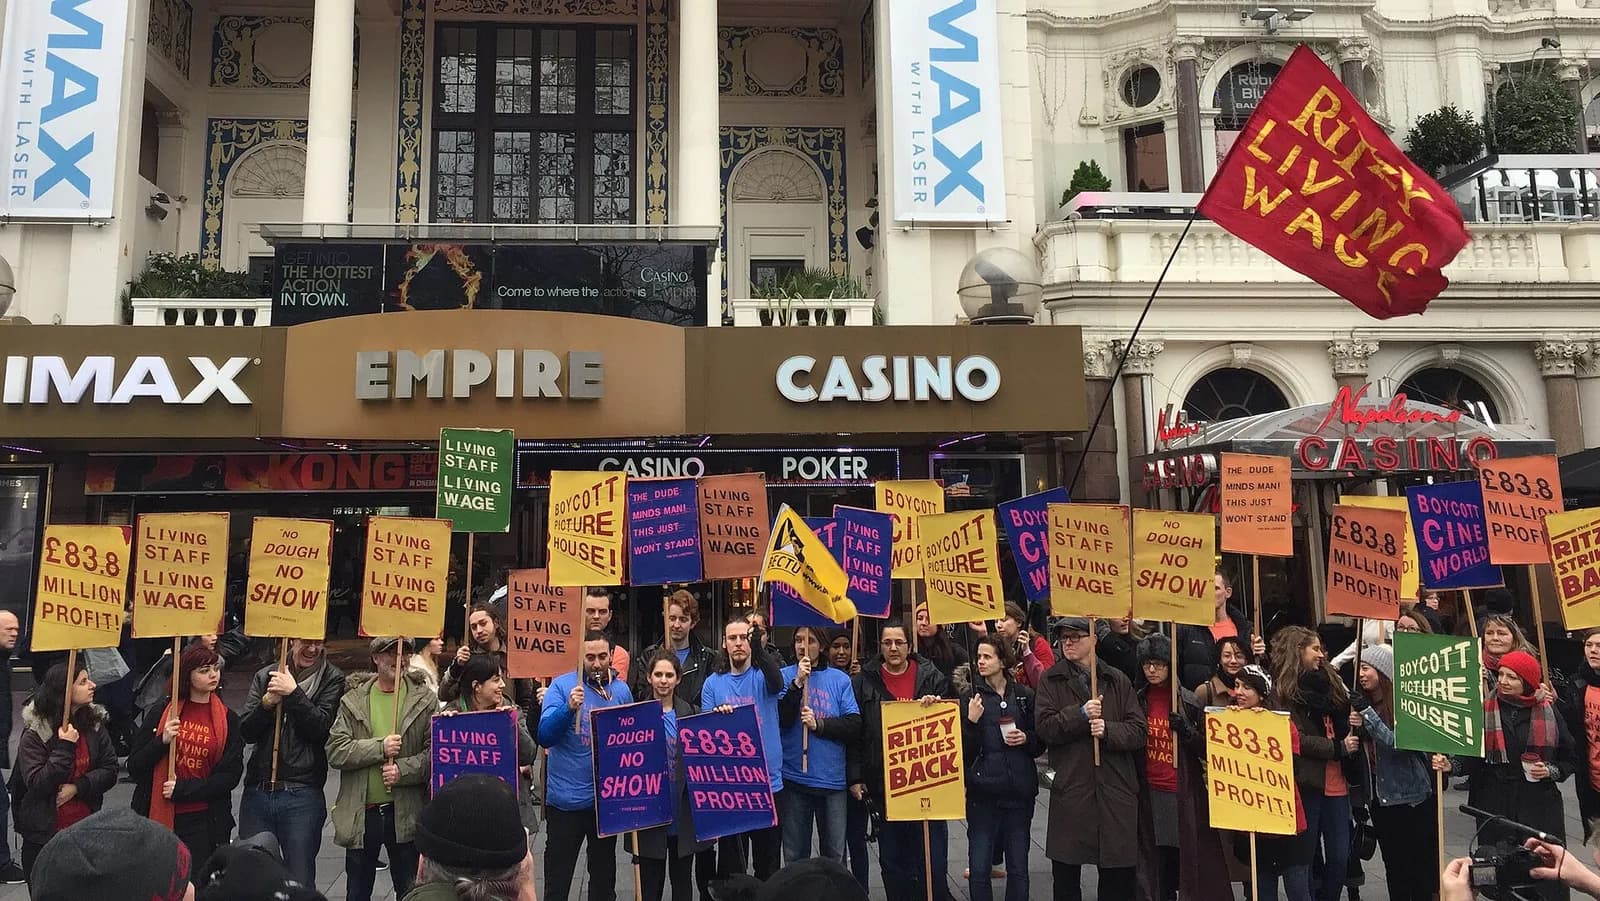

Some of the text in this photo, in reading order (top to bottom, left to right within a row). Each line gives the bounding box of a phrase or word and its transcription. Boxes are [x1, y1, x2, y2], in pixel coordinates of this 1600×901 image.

[11, 48, 36, 196] WITH LASER
[911, 62, 927, 202] WITH LASER
[282, 265, 374, 279] THE HOTTEST
[280, 280, 340, 292] ACTION
[498, 286, 646, 297] Come to where the action is
[280, 292, 349, 306] IN TOWN.
[2, 355, 254, 404] IMAX
[354, 348, 605, 400] EMPIRE
[776, 354, 1001, 402] CASINO
[446, 440, 496, 457] LIVING
[1299, 436, 1498, 470] CASINO
[268, 453, 406, 490] KONG
[445, 455, 498, 473] STAFF
[598, 456, 869, 480] CASINO POKER
[444, 476, 501, 494] LIVING
[654, 488, 680, 498] DUDE
[1482, 468, 1554, 500] £83.8
[444, 492, 496, 512] WAGE
[554, 476, 618, 516] BOYCOTT
[704, 489, 750, 501] LIVING
[885, 488, 937, 514] BOYCOTT
[632, 504, 686, 520] MINDS MAN!
[704, 503, 754, 518] STAFF
[1416, 494, 1480, 520] BOYCOTT
[1488, 500, 1558, 520] MILLIO
[554, 511, 614, 536] PICTURE
[633, 522, 679, 536] THIS JUST
[706, 524, 760, 538] LIVING
[848, 520, 880, 540] IVING
[1054, 516, 1110, 536] LIVING
[1492, 522, 1546, 545] PROFI
[146, 528, 208, 546] LIVING
[375, 530, 431, 551] LIVING
[926, 514, 984, 558] BOYCOTT
[1055, 532, 1114, 554] STAFF
[1146, 532, 1203, 549] DOUGH
[1334, 516, 1396, 556] £83.8
[1422, 519, 1483, 551] CINE
[45, 536, 120, 577] £83.8
[144, 545, 210, 566] STAFF
[264, 543, 319, 560] DOUGH
[553, 536, 616, 576] HOUSE!
[708, 541, 756, 555] WAGE
[846, 536, 881, 556] TAFF
[373, 548, 433, 569] STAFF
[846, 556, 883, 576] IVING
[928, 548, 988, 574] PICTURE
[1056, 554, 1119, 576] LIVING
[1160, 553, 1188, 568] NO
[1334, 548, 1399, 581] MILLION
[142, 570, 214, 590] LIVING
[276, 564, 304, 580] NO
[371, 571, 436, 593] LIVING
[43, 574, 121, 606] MILLION
[514, 582, 564, 597] LIVING
[850, 576, 878, 594] AGE
[1057, 574, 1114, 595] WAGE
[1334, 572, 1399, 605] PROFIT!
[1561, 566, 1600, 600] BA
[142, 589, 206, 611] WAGE
[371, 591, 428, 612] WAGE
[930, 578, 996, 610] HOUSE!
[514, 597, 567, 614] STAFF
[42, 602, 120, 631] PROFIT!
[513, 619, 571, 635] LIVING
[513, 636, 566, 654] WAGE
[1400, 641, 1471, 677] BOYCOTT
[1400, 677, 1470, 705] PICTURE
[183, 720, 210, 734] IVING
[1148, 716, 1169, 728] LIVI
[1148, 726, 1168, 738] STA
[1400, 698, 1474, 746] HOUSE!
[439, 729, 497, 745] LIVING
[607, 729, 655, 746] DOUGH
[679, 728, 757, 758] £83.8
[888, 716, 956, 750] RITZY
[1208, 718, 1284, 762] £83.8
[180, 741, 209, 757] IVING
[1147, 738, 1172, 750] LIVI
[439, 747, 502, 765] STAFF
[620, 751, 644, 768] NO
[1148, 750, 1173, 763] WAG
[688, 765, 767, 783] MILLION
[889, 751, 959, 790] BACK
[1212, 754, 1290, 791] MILLION
[693, 790, 773, 810] PROFIT!
[1214, 780, 1294, 818] PROFIT!
